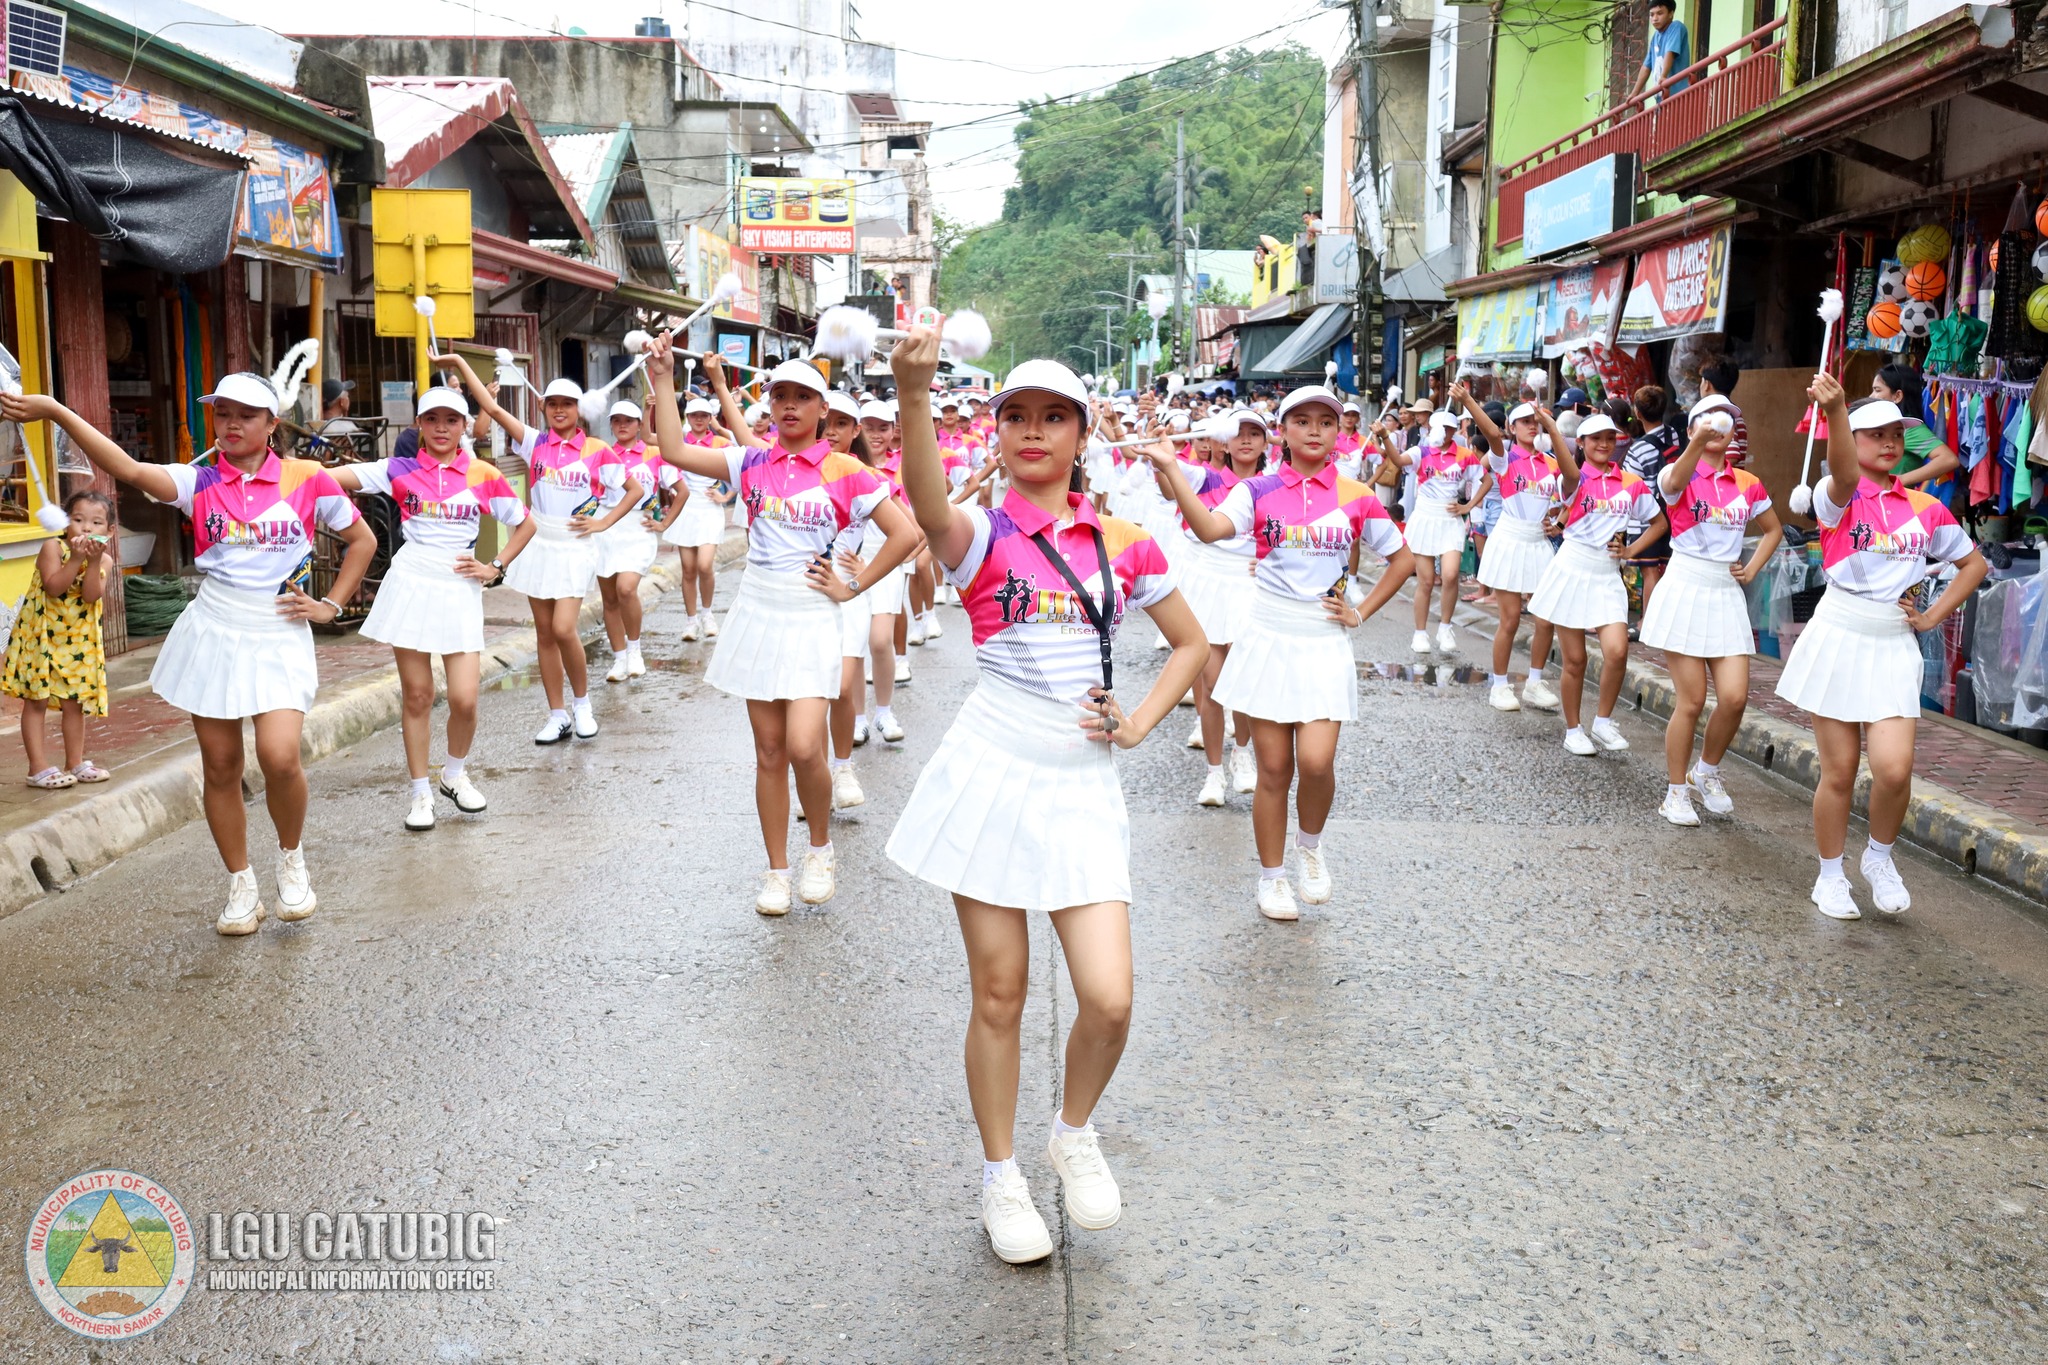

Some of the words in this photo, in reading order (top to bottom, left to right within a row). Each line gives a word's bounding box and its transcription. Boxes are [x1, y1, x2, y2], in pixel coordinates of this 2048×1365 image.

[1544, 201, 1569, 228] LINCOLN
[1569, 191, 1591, 218] STORE
[743, 229, 760, 247] SKY
[762, 229, 792, 248] VISION
[793, 229, 852, 249] ENTERPRISES
[1667, 247, 1680, 280] NO
[1680, 238, 1710, 277] PRICE
[764, 496, 834, 526] HNHS
[226, 519, 301, 546] HNHS
[779, 522, 818, 533] Ensemble
[1286, 525, 1352, 549] HNHS
[1047, 612, 1076, 621] Elite
